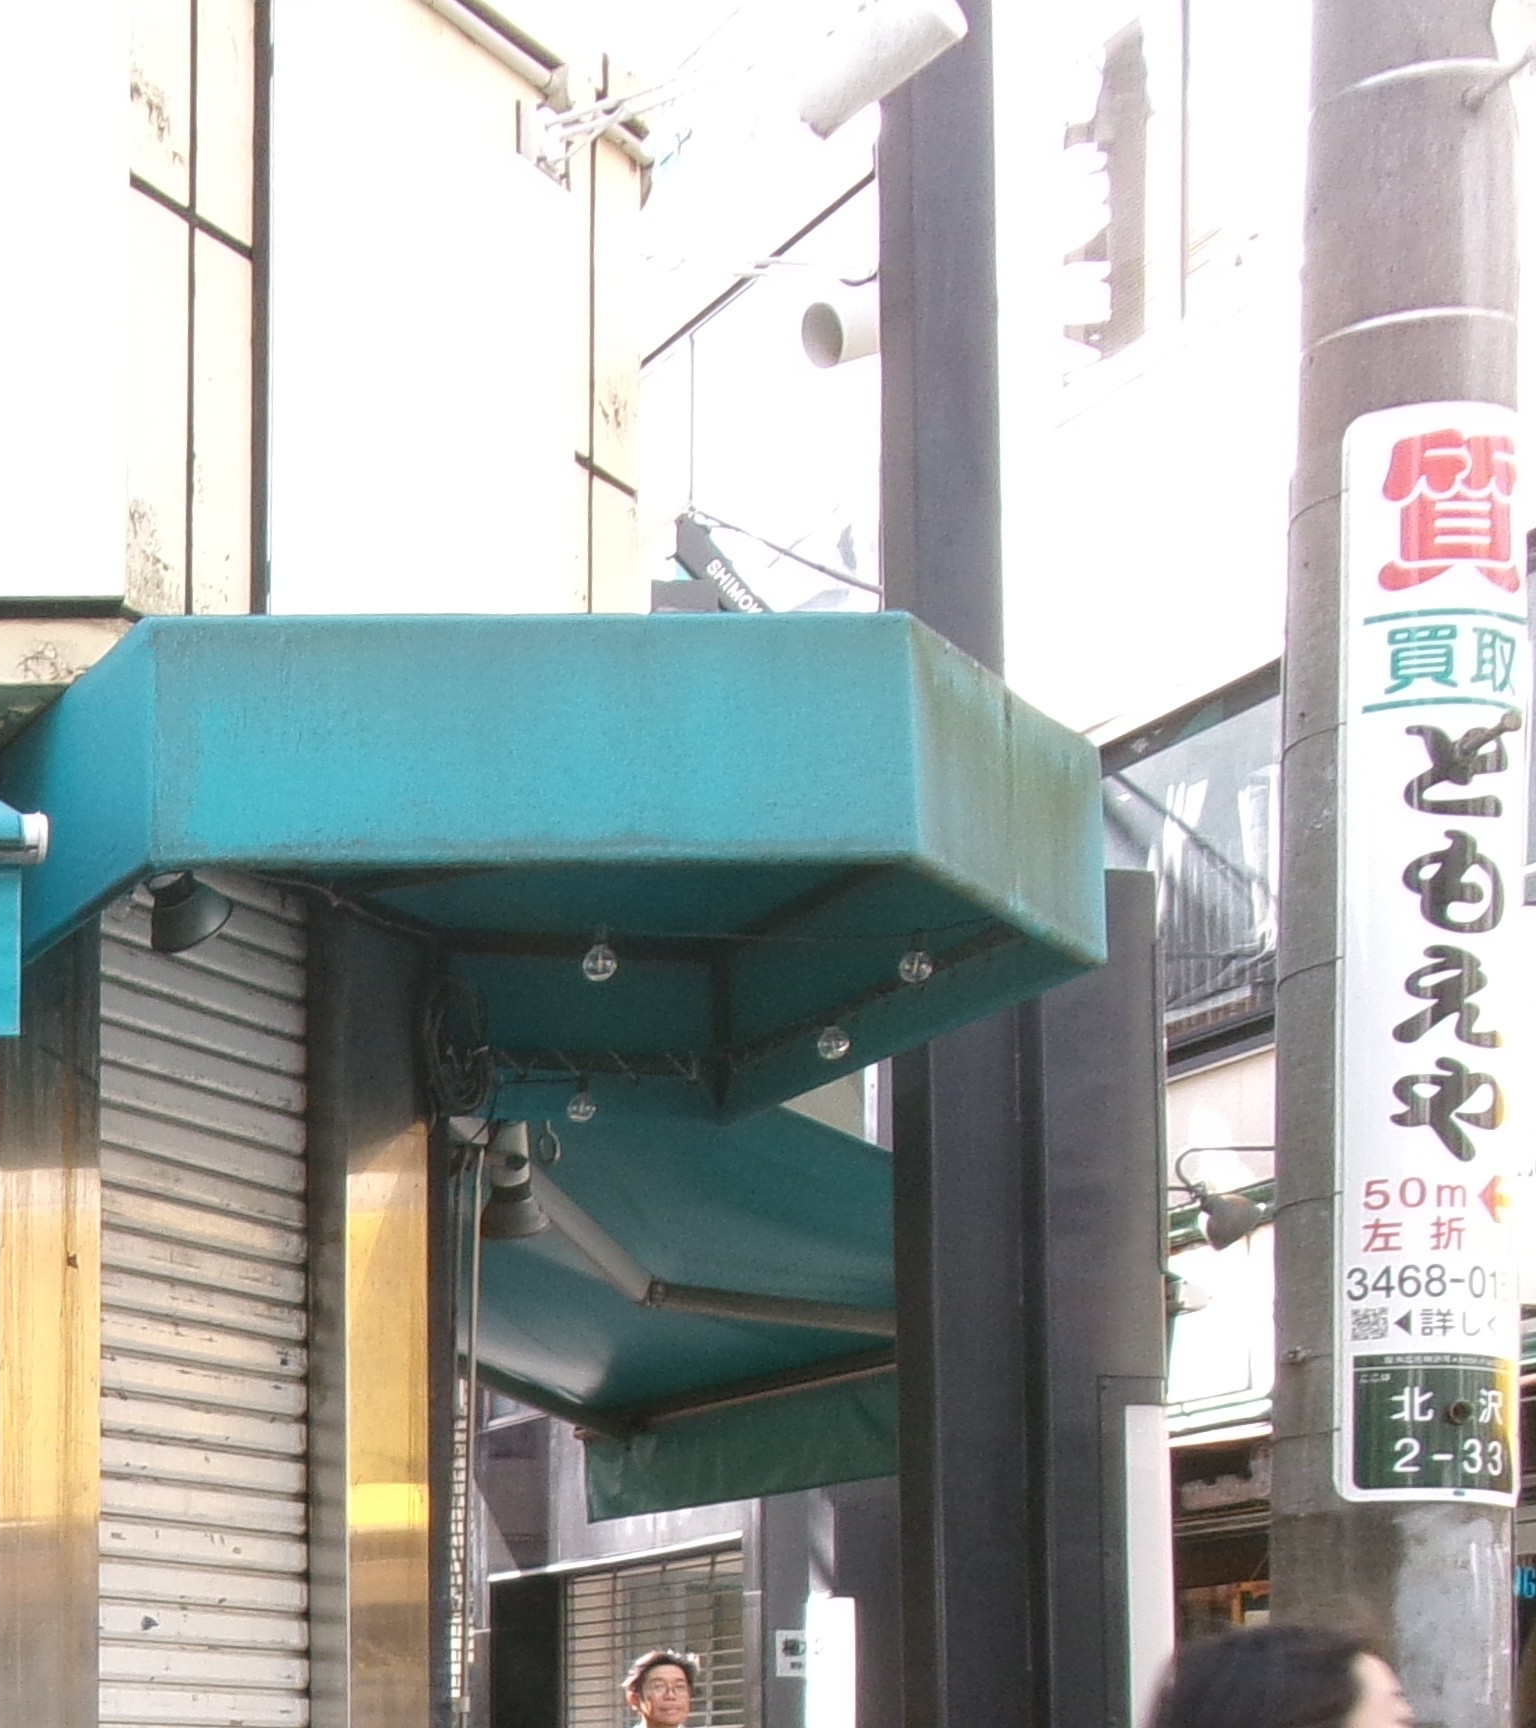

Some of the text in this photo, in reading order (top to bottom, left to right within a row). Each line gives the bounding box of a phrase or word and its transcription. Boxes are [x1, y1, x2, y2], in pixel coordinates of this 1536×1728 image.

[1377, 428, 1521, 593] 質
[1385, 624, 1517, 697] 買取
[1362, 1177, 1467, 1211] 50m
[1361, 1216, 1466, 1253] 左折
[1389, 1386, 1504, 1426] 北沢
[1392, 1437, 1503, 1477] 2-33
